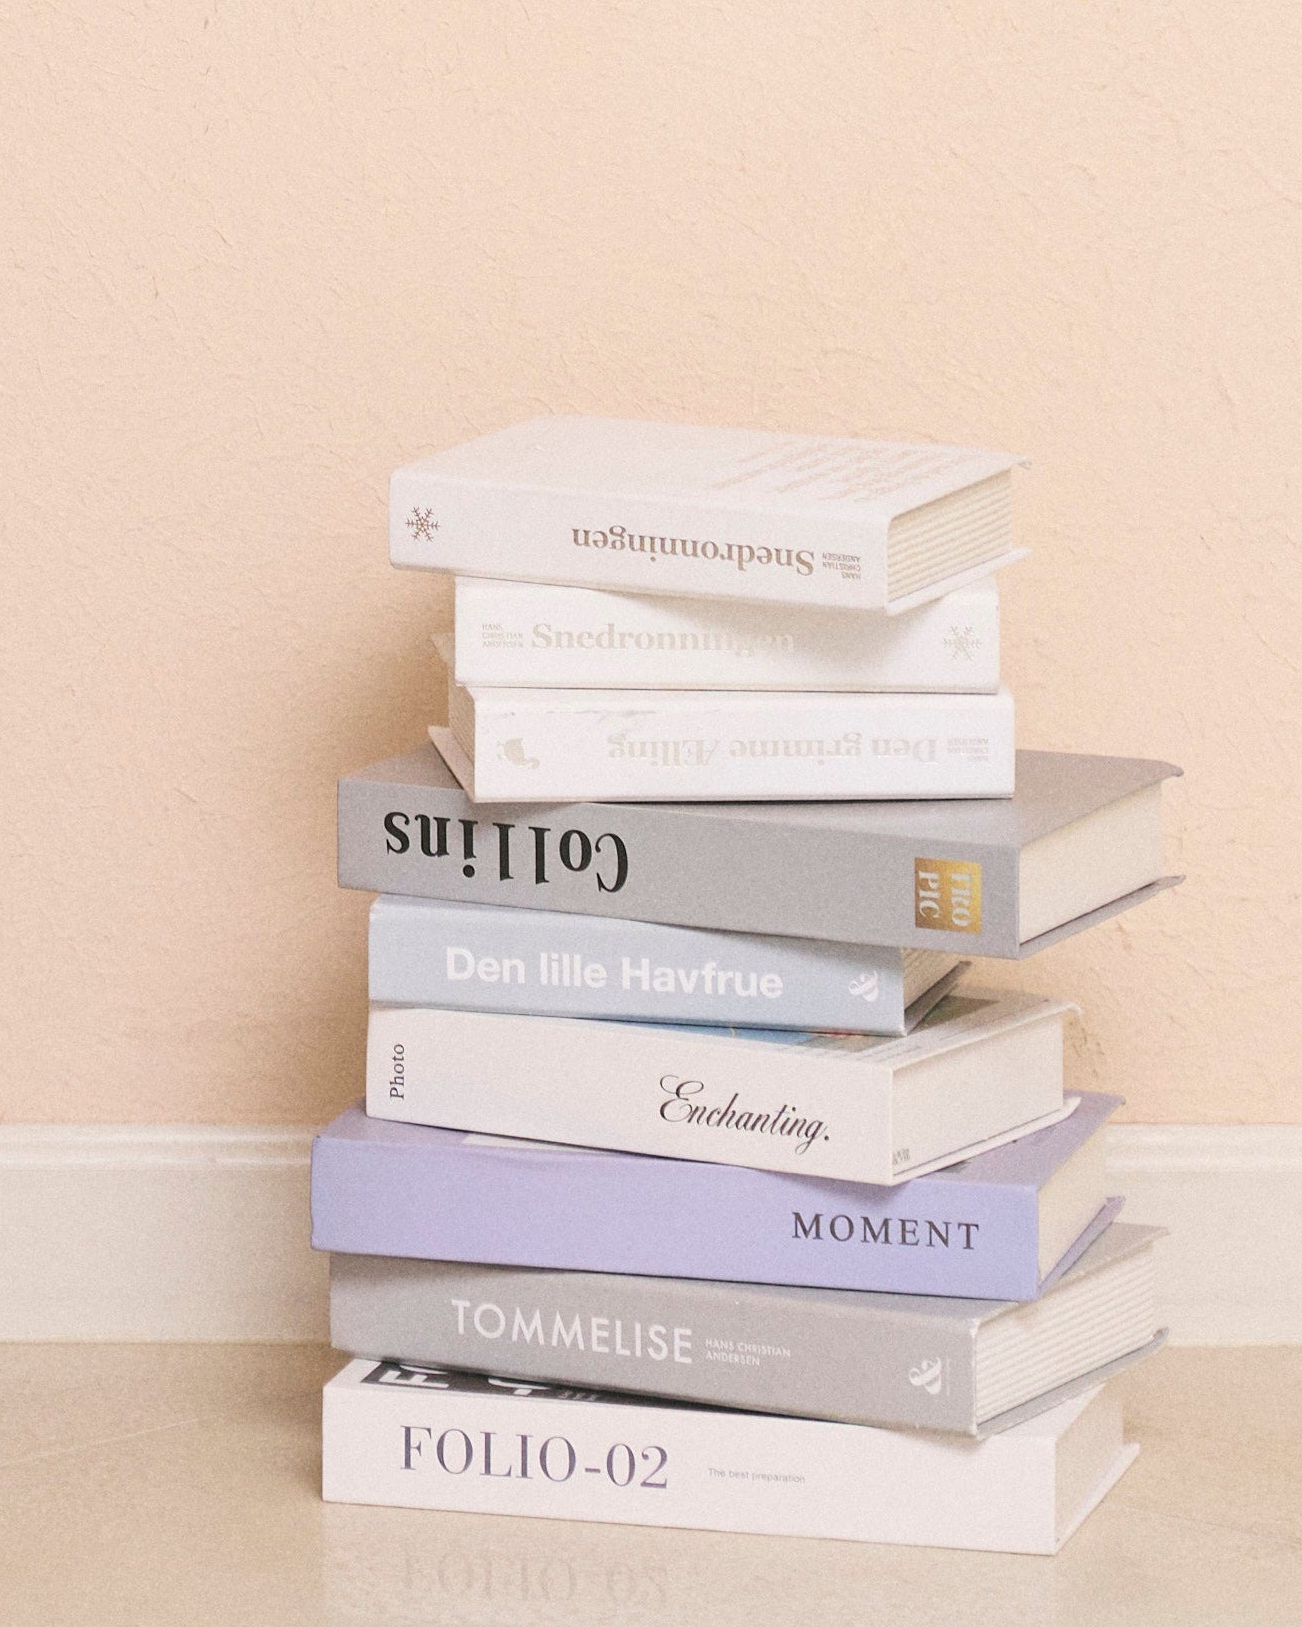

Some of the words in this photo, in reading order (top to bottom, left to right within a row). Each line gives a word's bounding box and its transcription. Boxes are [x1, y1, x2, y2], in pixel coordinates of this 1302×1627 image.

[572, 525, 814, 576] Snedronningen
[729, 732, 862, 765] grimme
[872, 738, 938, 763] Den
[384, 810, 629, 893] Collins
[918, 870, 941, 919] PIC
[446, 947, 526, 984] Den
[539, 952, 607, 989] lille
[621, 957, 784, 999] Havfrue
[390, 1042, 405, 1100] Photo
[659, 1074, 830, 1155] Enchanting.
[792, 1211, 981, 1251] MOMENT
[452, 1299, 693, 1364] TOMMELISE
[705, 1338, 736, 1351] HANS
[737, 1342, 792, 1359] CHRISTIAN
[705, 1351, 760, 1367] ANDERSEN
[400, 1425, 669, 1490] FOLIO-02
[708, 1467, 726, 1478] The
[728, 1470, 750, 1481] best
[751, 1472, 806, 1484] preparation
